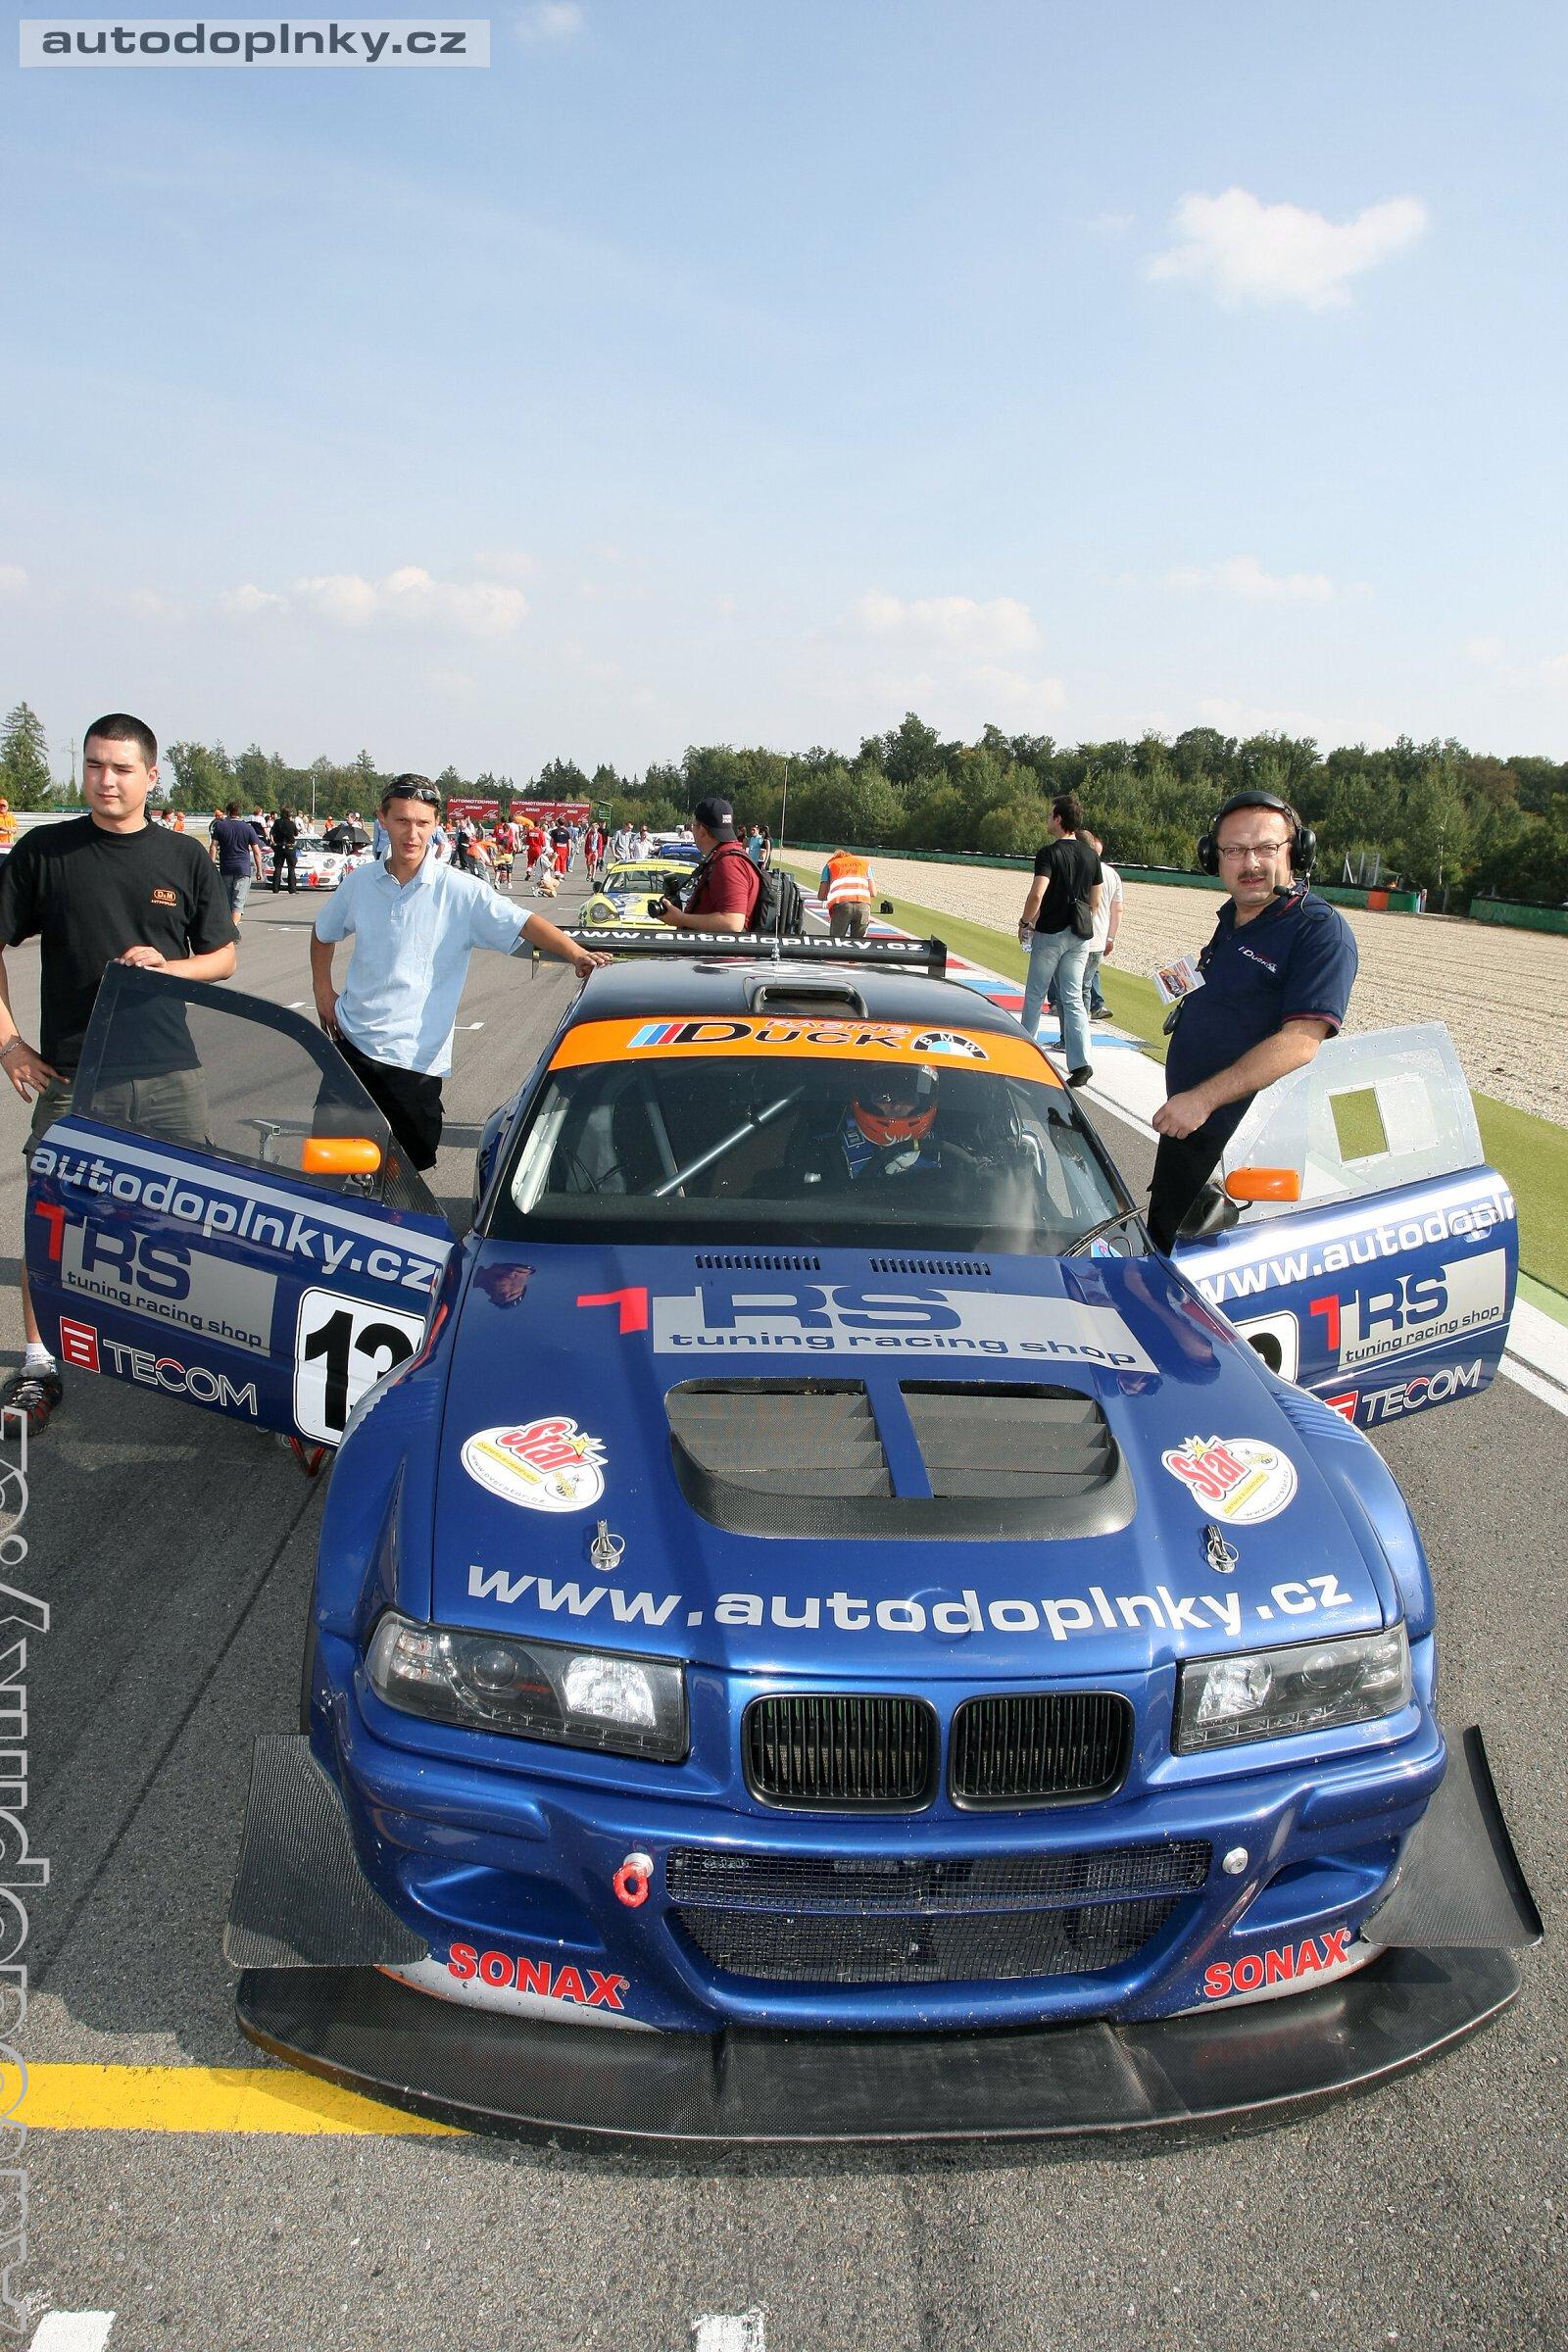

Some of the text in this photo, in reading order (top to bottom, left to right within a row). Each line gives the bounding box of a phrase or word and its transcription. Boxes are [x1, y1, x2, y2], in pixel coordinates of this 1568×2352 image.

[764, 1019, 912, 1035] RACING
[918, 1032, 982, 1054] BMW
[30, 1148, 436, 1293] autodoplnky.cz
[68, 1271, 262, 1348] tuning racing shop
[1346, 1305, 1499, 1363] tuning racing shop
[103, 1339, 258, 1415] TECOM
[669, 1331, 1137, 1366] tuning racing shop
[1362, 1359, 1483, 1422] TECOM
[467, 1565, 1352, 1642] www.autodoplnky.cz
[447, 1942, 625, 2009] SONAX
[1203, 1928, 1348, 1998] SONAX
